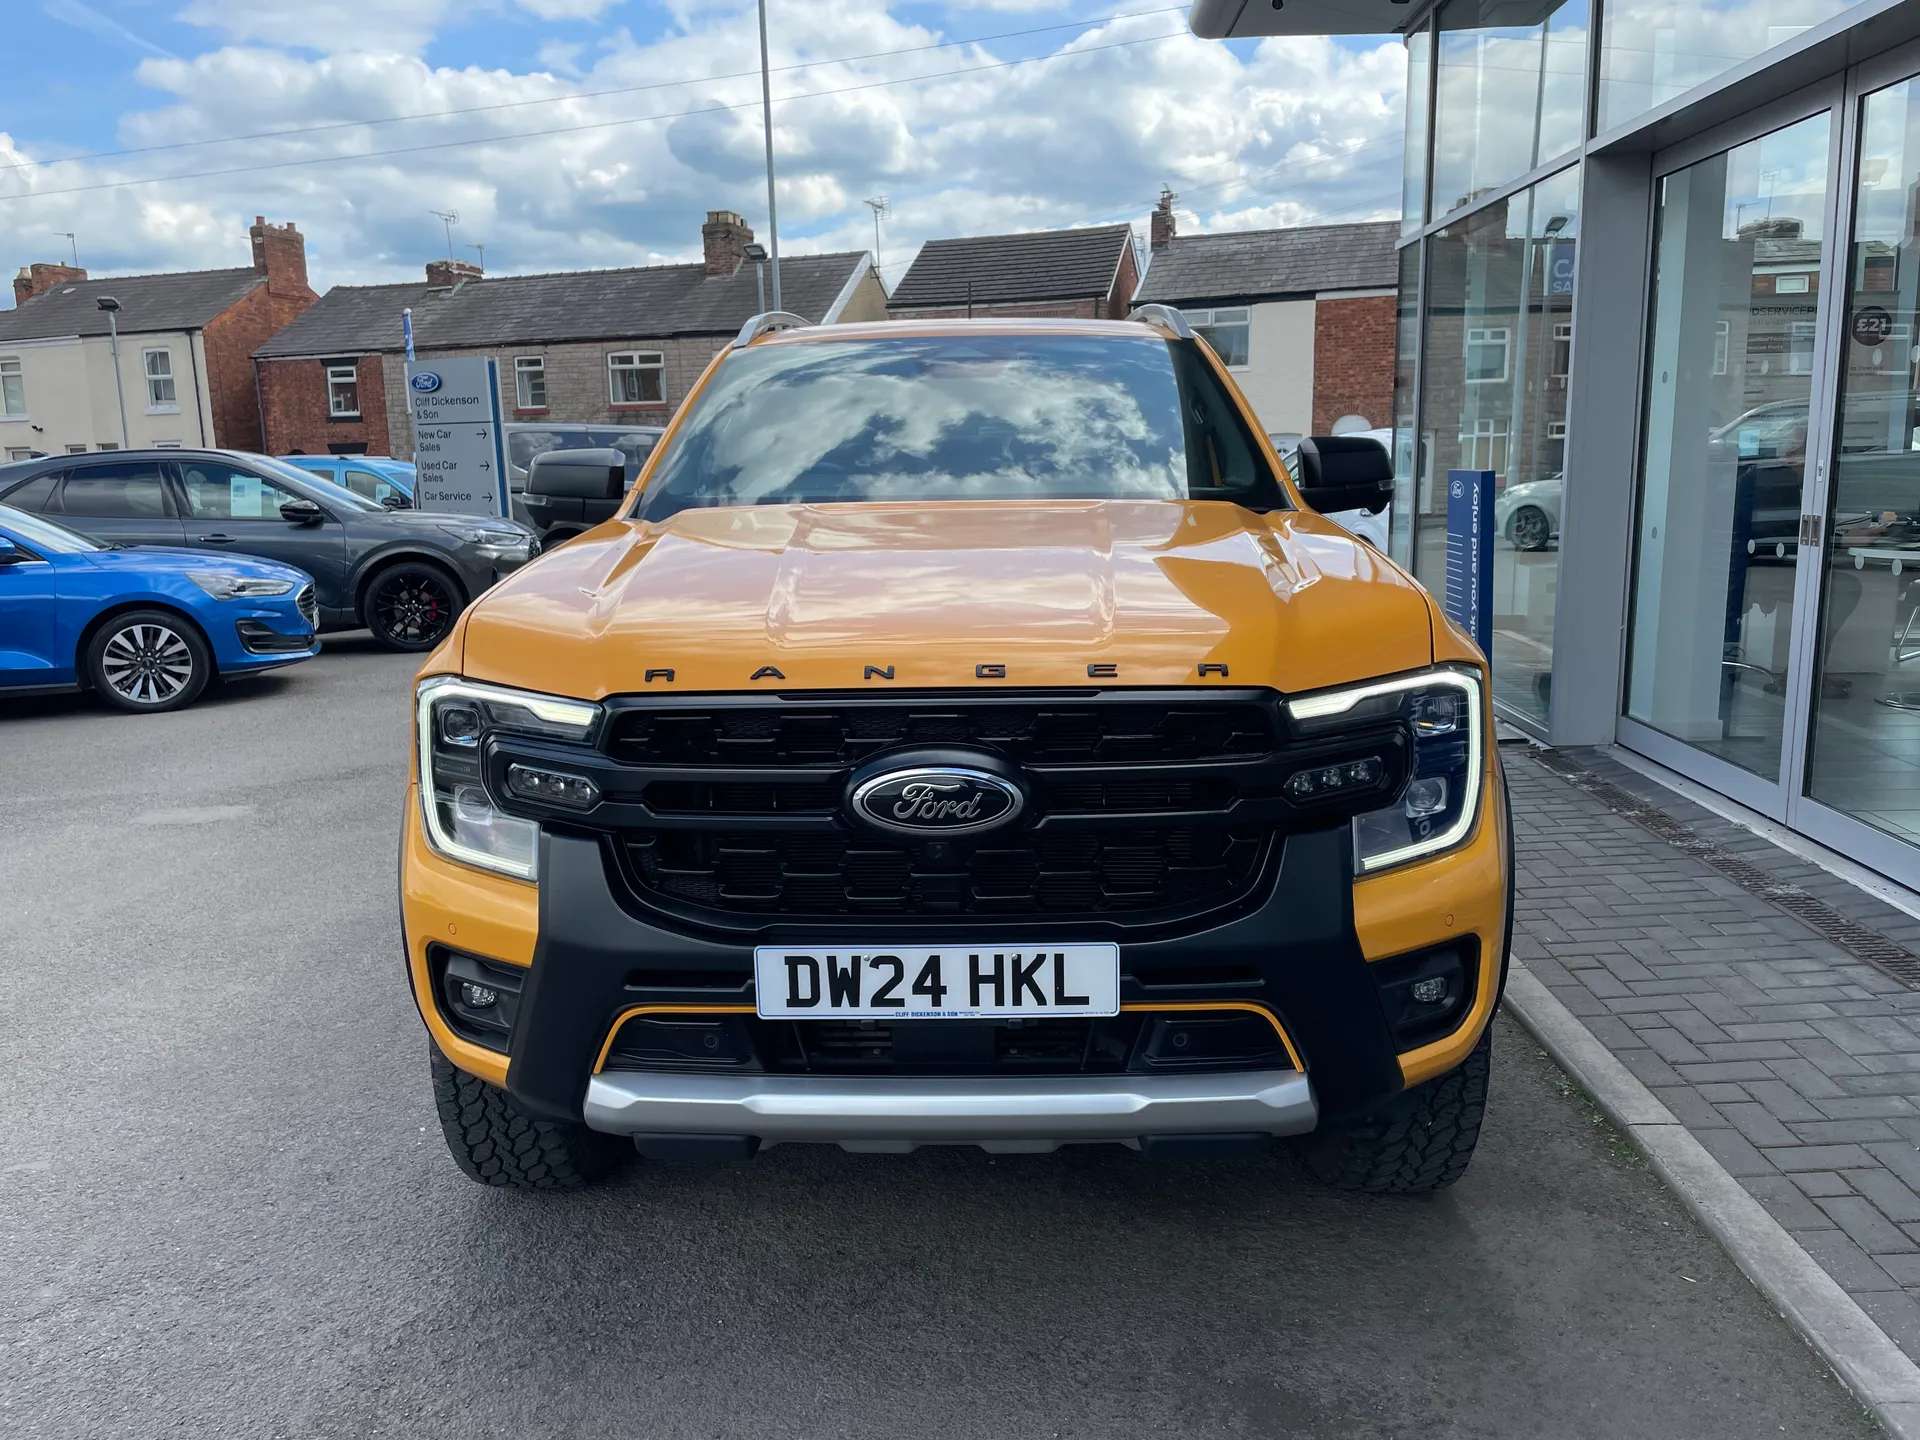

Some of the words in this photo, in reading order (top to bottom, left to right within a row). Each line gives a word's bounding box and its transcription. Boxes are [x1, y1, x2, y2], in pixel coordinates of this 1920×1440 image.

[415, 397, 430, 407] Cliff
[431, 395, 480, 406] Dickenson
[423, 409, 439, 419] Son
[418, 430, 435, 440] New
[436, 429, 452, 439] Car
[419, 442, 441, 452] Sales
[421, 461, 441, 471] Used
[441, 460, 457, 470] Car
[422, 473, 444, 483] Sales
[424, 491, 439, 501] Car
[439, 491, 472, 501] Service
[1471, 482, 1480, 534] enjoy
[1470, 577, 1478, 612] you
[644, 663, 1230, 682] RANGER
[893, 782, 984, 820] Ford
[784, 954, 948, 1008] DW24
[968, 953, 1090, 1007] HKL
